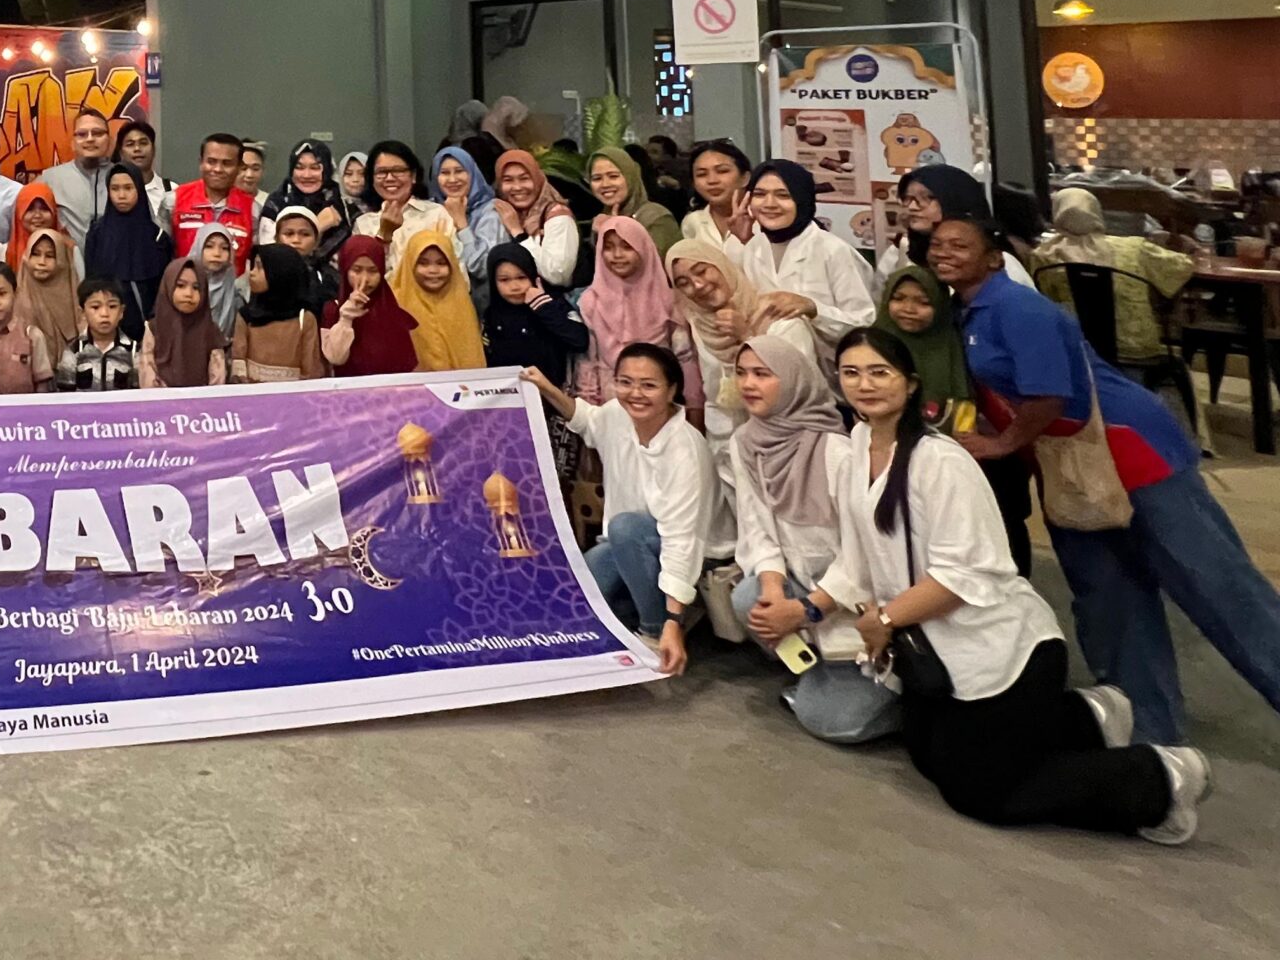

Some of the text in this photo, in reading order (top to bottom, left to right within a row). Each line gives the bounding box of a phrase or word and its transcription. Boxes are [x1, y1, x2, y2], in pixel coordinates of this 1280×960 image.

[474, 387, 519, 396] PERTAMINA
[51, 417, 167, 440] Pertamina
[170, 411, 242, 436] Peduli
[8, 450, 198, 479] Mempersembahkan
[84, 604, 139, 633] Baju
[144, 600, 237, 629] Lebaran
[243, 602, 294, 623] 2024
[301, 580, 355, 623] 3.0
[14, 645, 259, 687] Jayapura, 1 April 2024
[33, 709, 109, 730] Manusia
